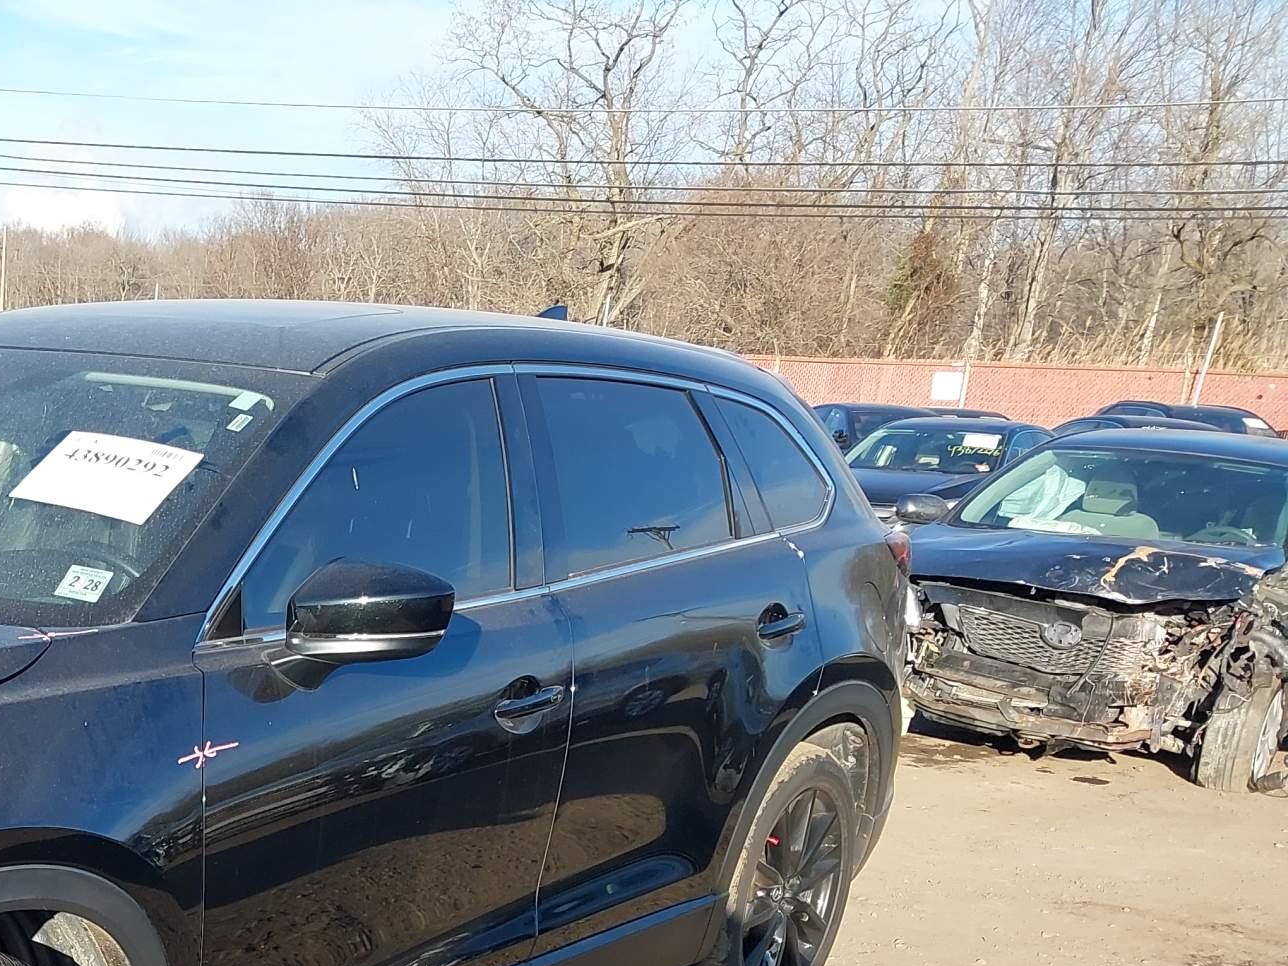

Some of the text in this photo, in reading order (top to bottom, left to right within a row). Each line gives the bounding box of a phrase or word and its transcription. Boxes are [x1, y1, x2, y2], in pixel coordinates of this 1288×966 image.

[64, 448, 170, 478] 43890292
[68, 575, 102, 592] 2 28
